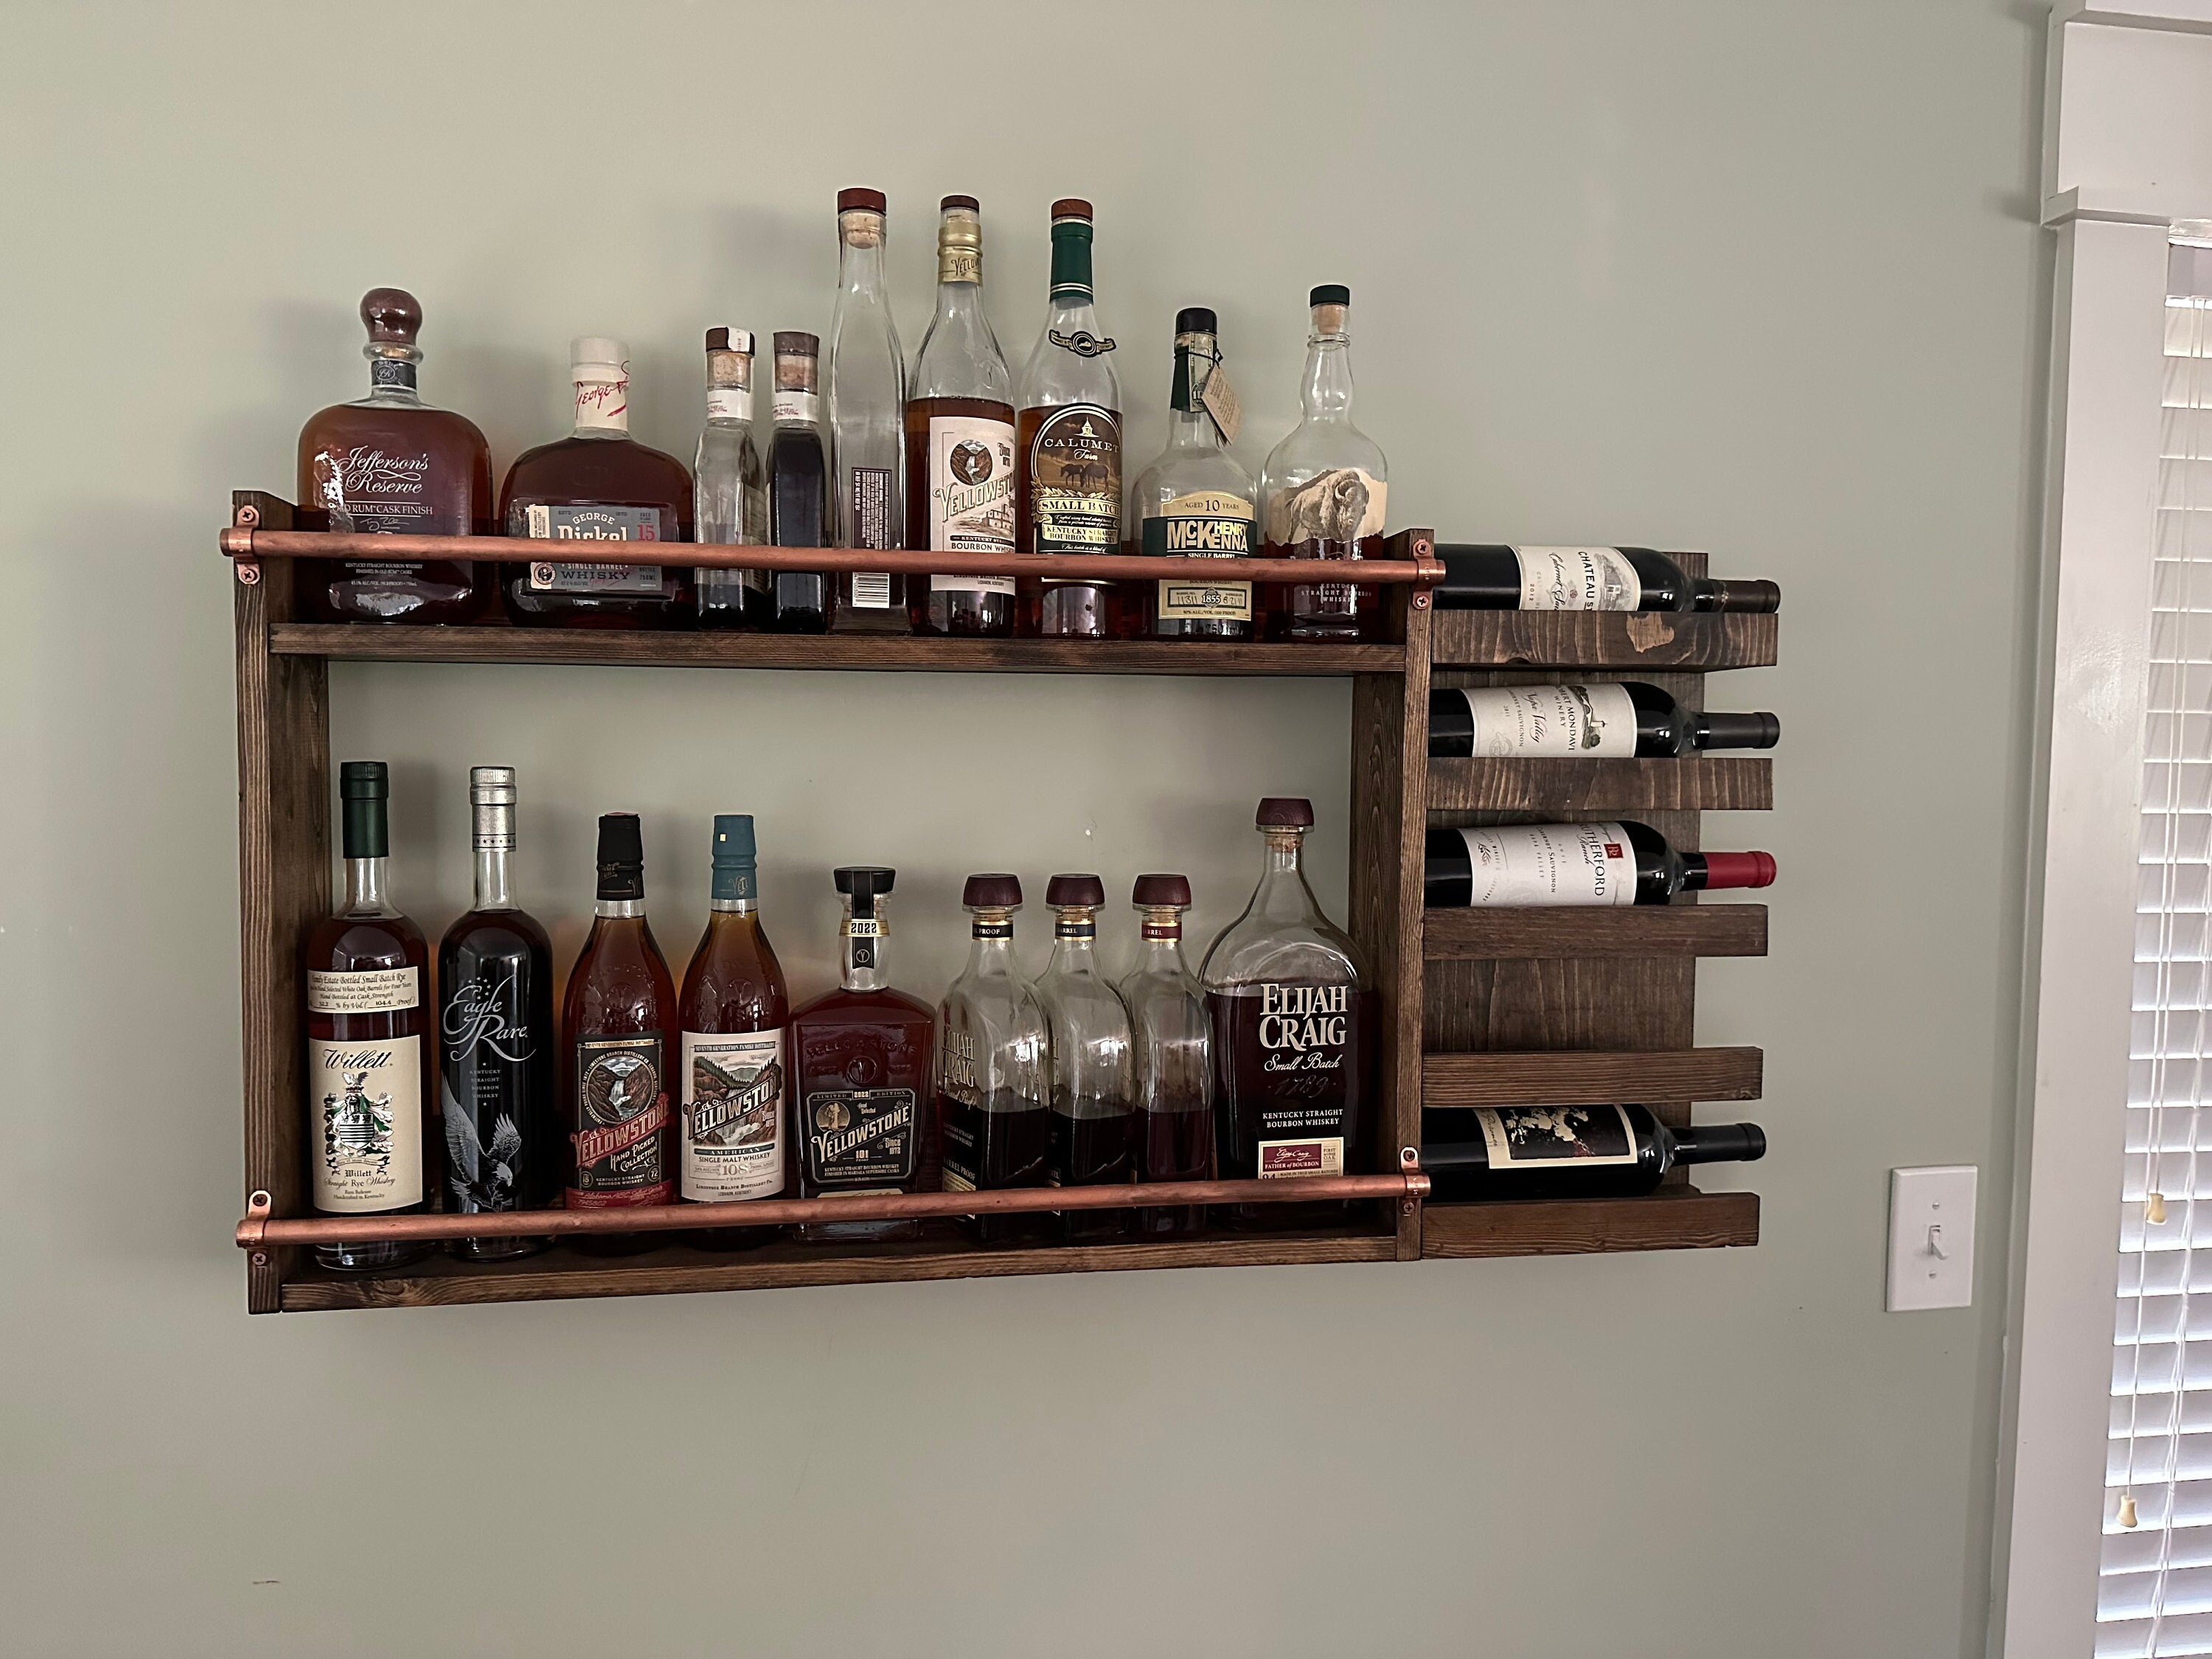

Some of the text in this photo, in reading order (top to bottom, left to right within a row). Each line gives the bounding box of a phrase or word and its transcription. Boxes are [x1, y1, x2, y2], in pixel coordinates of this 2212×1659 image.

[1044, 439, 1119, 453] CALUMET
[336, 445, 428, 474] Jefferson's
[1074, 448, 1098, 461] Farm
[345, 470, 422, 493] Reserve
[933, 470, 1015, 523] YELLOWSTO
[377, 505, 400, 514] CASK
[403, 506, 433, 515] FINISH
[1042, 501, 1120, 515] SMALL BATCH
[1206, 500, 1220, 511] 10
[572, 512, 615, 525] GEORGE
[637, 524, 655, 540] 15
[1047, 526, 1086, 535] KENTUCKY
[1214, 521, 1248, 536] HENRY
[1050, 532, 1086, 540] BOURBON
[951, 542, 992, 551] BOURBON
[560, 571, 630, 580] WHISKY
[1549, 553, 1566, 590] Cabernet
[1578, 552, 1595, 599] CHATEAU
[1202, 594, 1221, 604] 1855
[1554, 695, 1566, 728] WINERY
[1558, 687, 1576, 751] BERT MONDAVI
[1529, 710, 1548, 743] Valley
[1576, 834, 1596, 868] Ranch
[851, 922, 877, 933] 2022
[340, 975, 361, 984] Bottled
[361, 974, 379, 984] Small
[379, 973, 395, 982] Batch
[397, 973, 406, 983] Rye
[356, 985, 367, 993] Oak
[357, 992, 372, 1001] Cask
[372, 991, 394, 999] Strength
[1260, 984, 1349, 1020] ELIJAH
[343, 1002, 350, 1010] by
[443, 975, 515, 1044] Eagle
[451, 1015, 537, 1062] Rare
[1259, 1015, 1347, 1051] CRAIG
[323, 1049, 392, 1069] Willett
[624, 1051, 644, 1060] DISTILLERY
[1264, 1052, 1343, 1071] Small Batch
[683, 1076, 782, 1140] YELLOWSTON
[1262, 1109, 1343, 1119] KENTUCKY STRAIGHT
[1267, 1118, 1340, 1128] BOURBON WHISKEY
[811, 1106, 909, 1164] YELLOWSTONE
[709, 1147, 760, 1155] AMERICAN
[743, 1152, 771, 1161] WHISKEY
[855, 1150, 869, 1158] 101
[345, 1169, 372, 1178] Willett
[650, 1169, 658, 1178] 72
[722, 1163, 750, 1175] 108
[961, 1166, 975, 1180] PROOF
[351, 1180, 364, 1188] Rye
